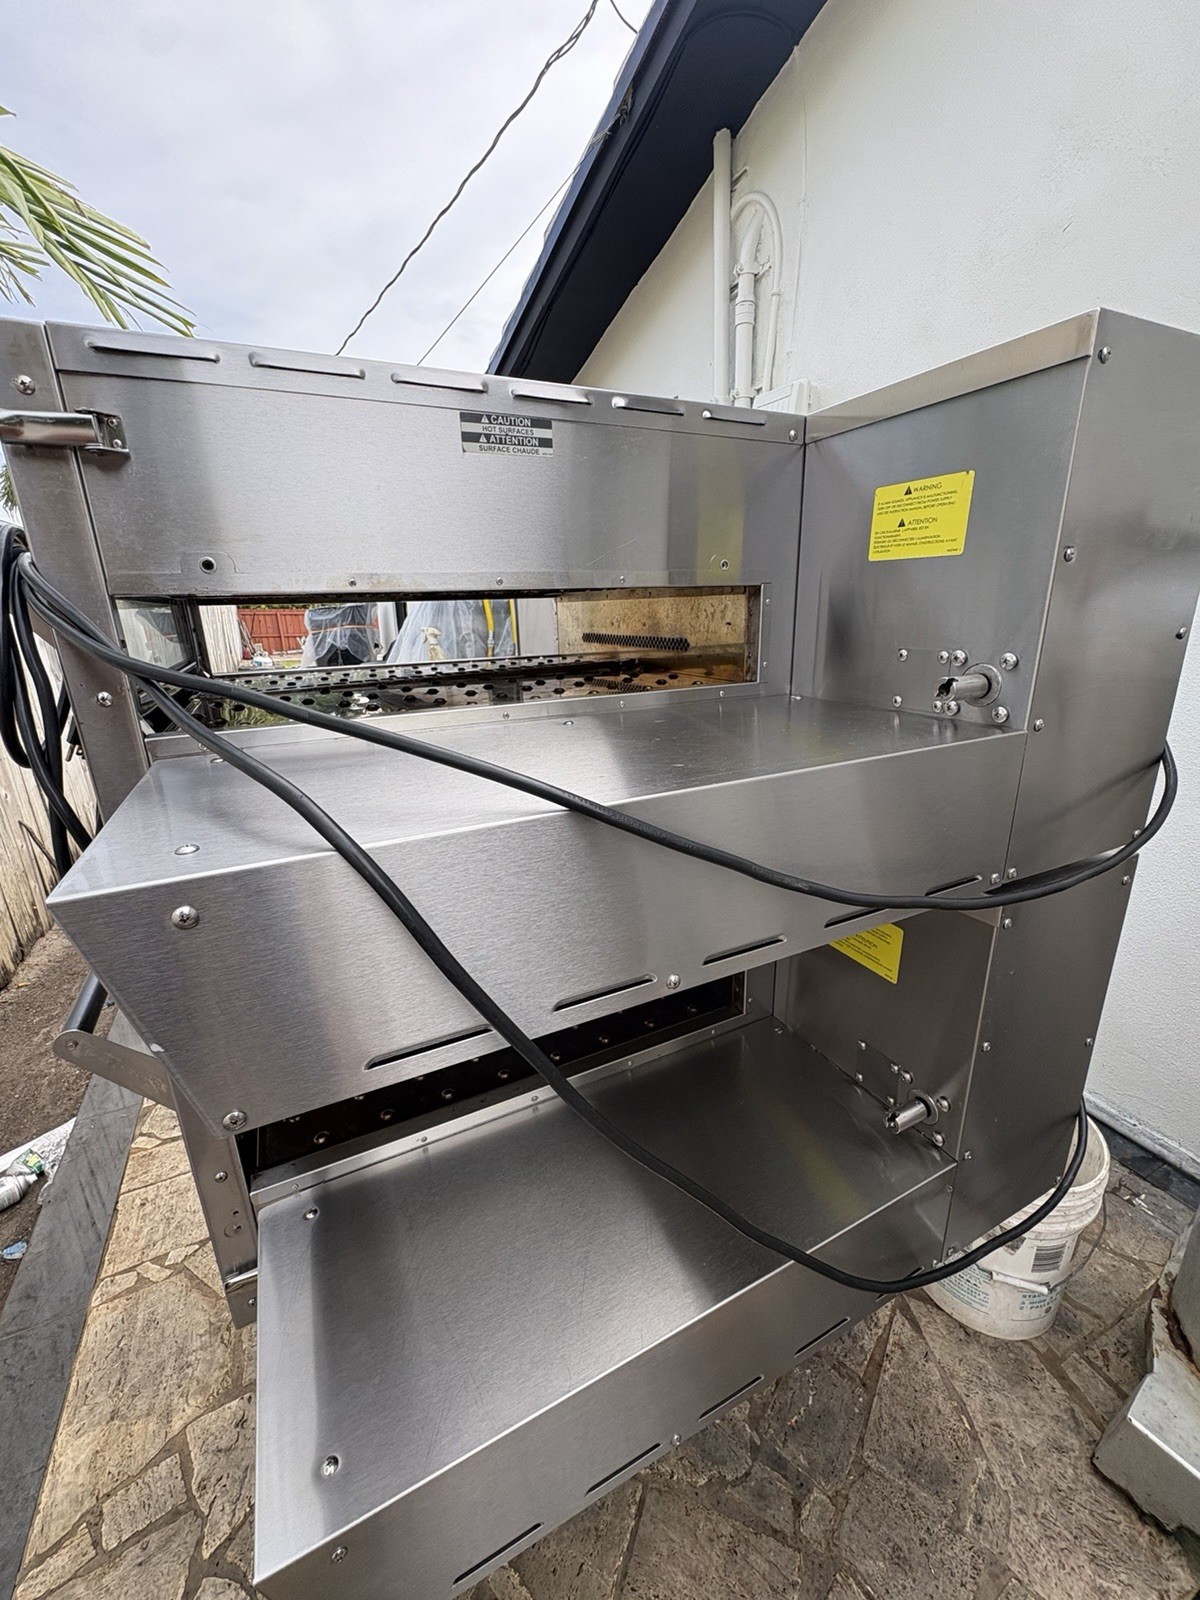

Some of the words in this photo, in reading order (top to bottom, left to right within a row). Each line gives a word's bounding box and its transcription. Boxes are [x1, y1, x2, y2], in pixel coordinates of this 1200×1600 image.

[490, 415, 531, 427] CAUTION
[482, 425, 497, 433] HOT
[499, 427, 534, 436] SURFACES
[489, 434, 539, 447] ATTENTION
[479, 444, 510, 453] SURFACE
[512, 446, 539, 455] CHAUDE
[913, 482, 942, 492] WARNING
[907, 517, 937, 526] ATTENTION
